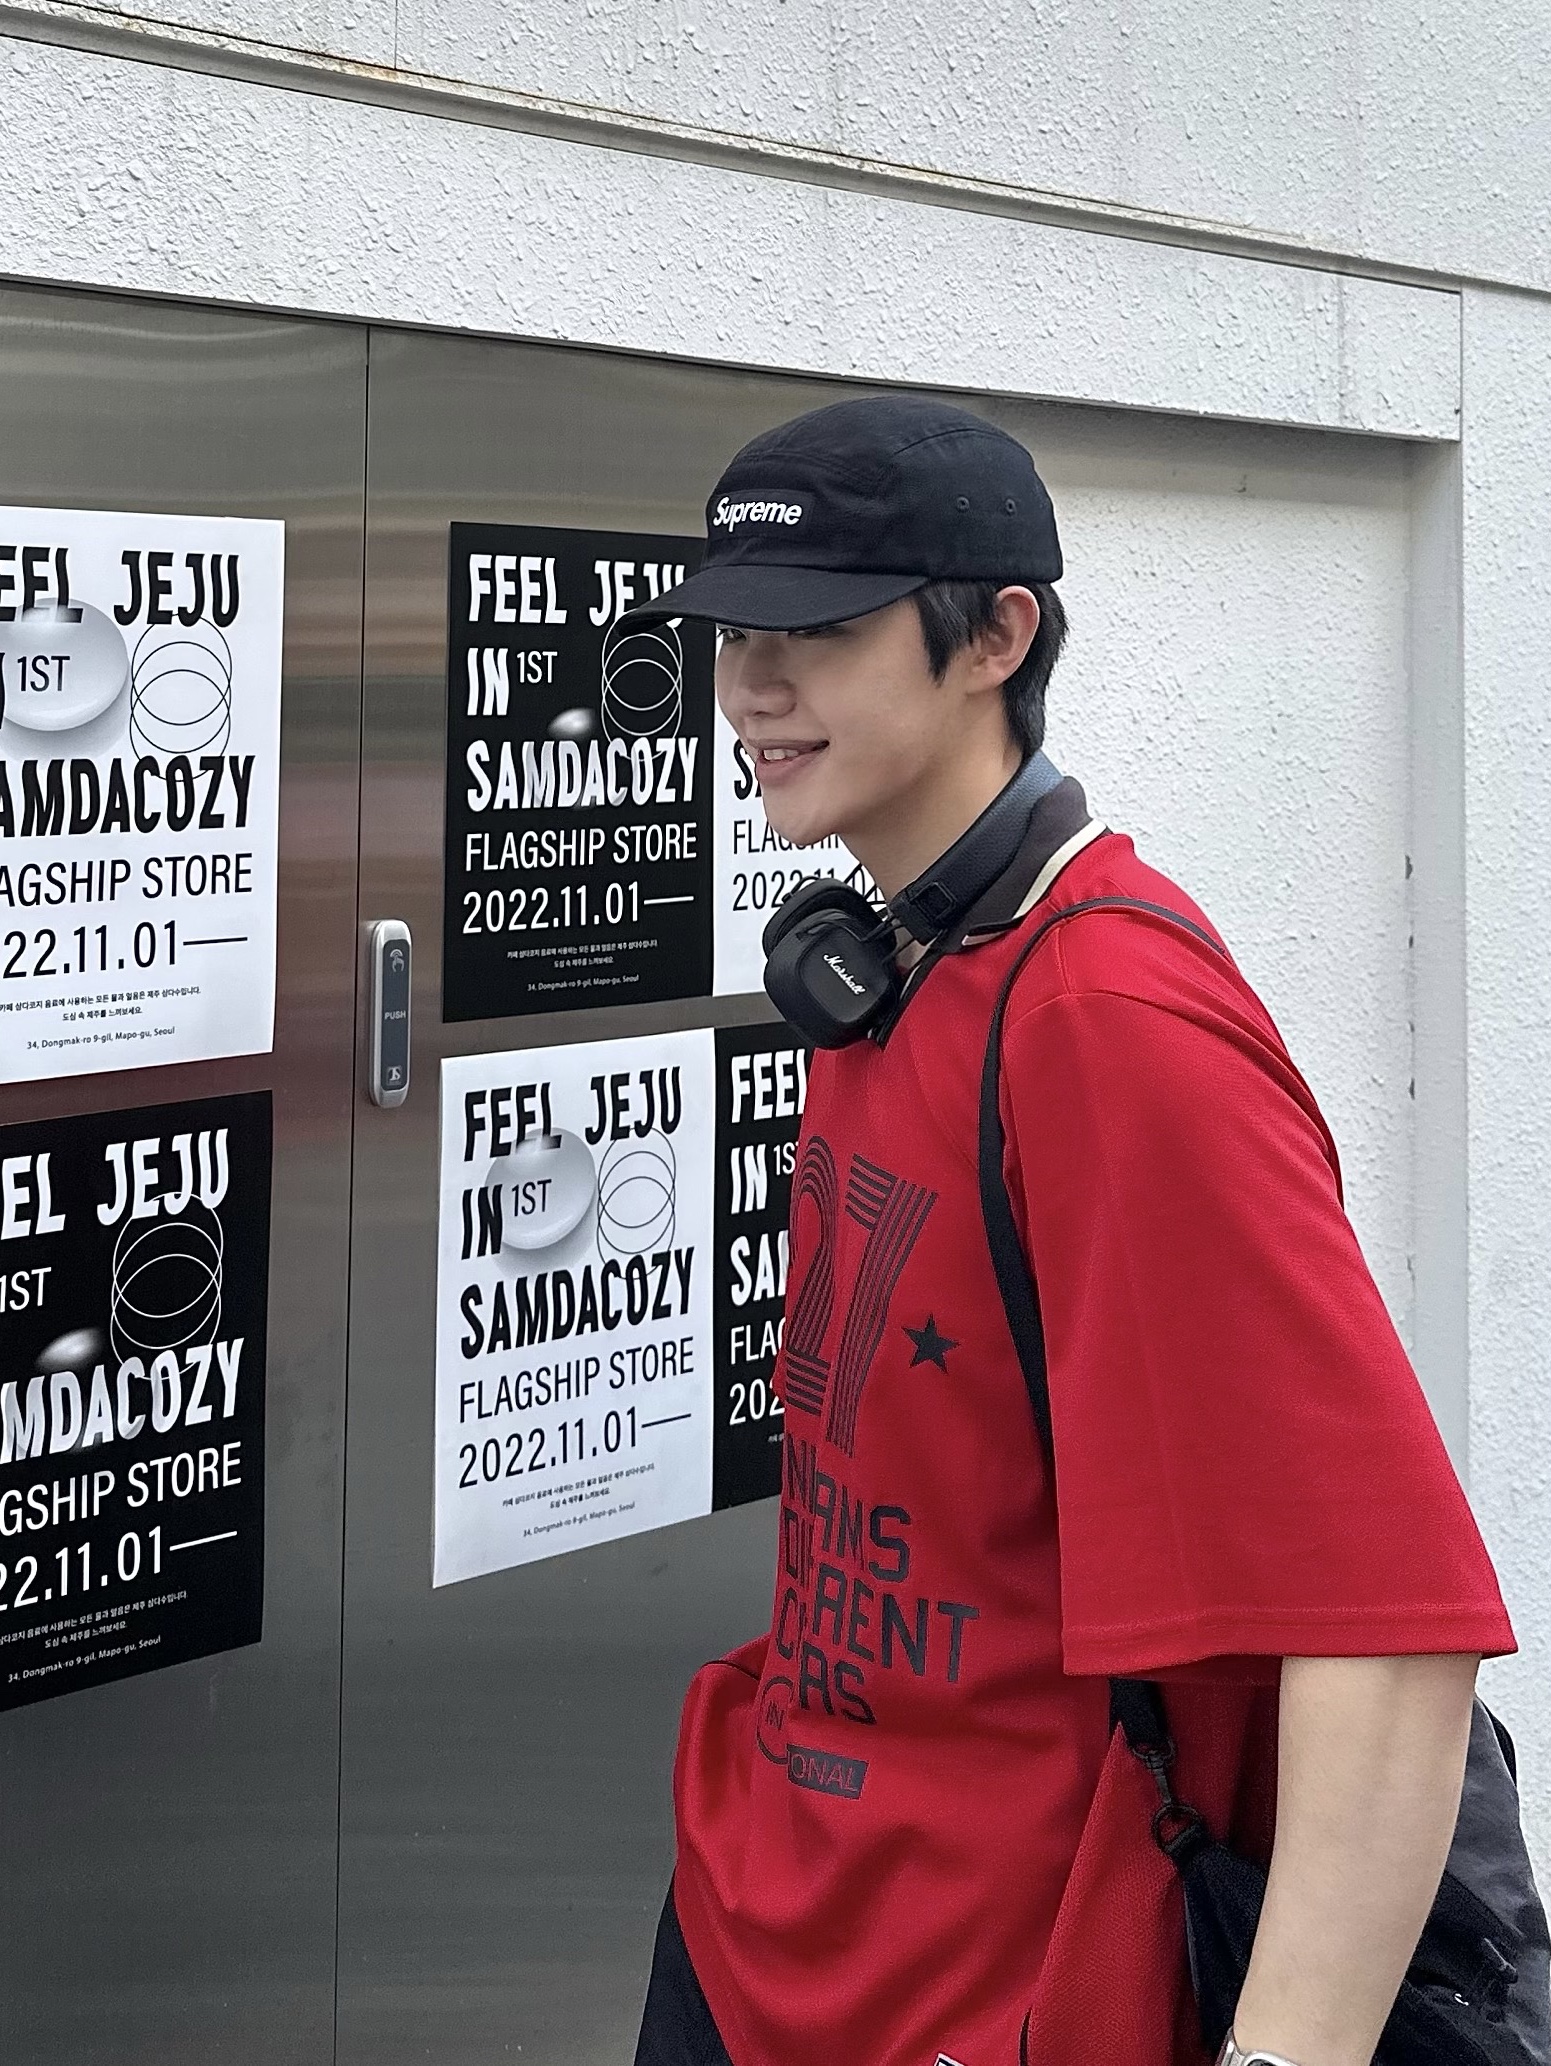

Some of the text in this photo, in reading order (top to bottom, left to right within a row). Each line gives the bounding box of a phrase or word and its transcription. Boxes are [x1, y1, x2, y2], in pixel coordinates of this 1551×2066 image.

[713, 496, 803, 532] Supreme
[113, 550, 240, 628] JEJU
[468, 553, 567, 624] FEEL
[17, 654, 71, 692] 1ST
[467, 647, 558, 716] IN 1ST
[466, 736, 699, 812] SAMDACOZY
[142, 853, 253, 900] STORE
[465, 828, 606, 872] FLAGSHIP
[613, 823, 698, 864] STORE
[823, 954, 866, 995] Marshall
[26, 1026, 175, 1049] 34, Dongmak-ro 9-gil, Mapo-gu, Seoul
[384, 1011, 406, 1020] PUSH
[463, 1065, 683, 1162] FEEL JEJU
[1, 1128, 230, 1240] EL JEJU
[731, 1142, 799, 1214] IN 1S
[460, 1178, 552, 1260] IN 1ST
[0, 1267, 52, 1313] 1ST
[460, 1246, 695, 1359] SAMDACOZY
[0, 1337, 245, 1464] MDACOZY
[459, 1336, 694, 1423] FLAGSHIP STORE
[0, 1441, 242, 1536] GSHIP STORE
[138, 1636, 160, 1648] Seoul
